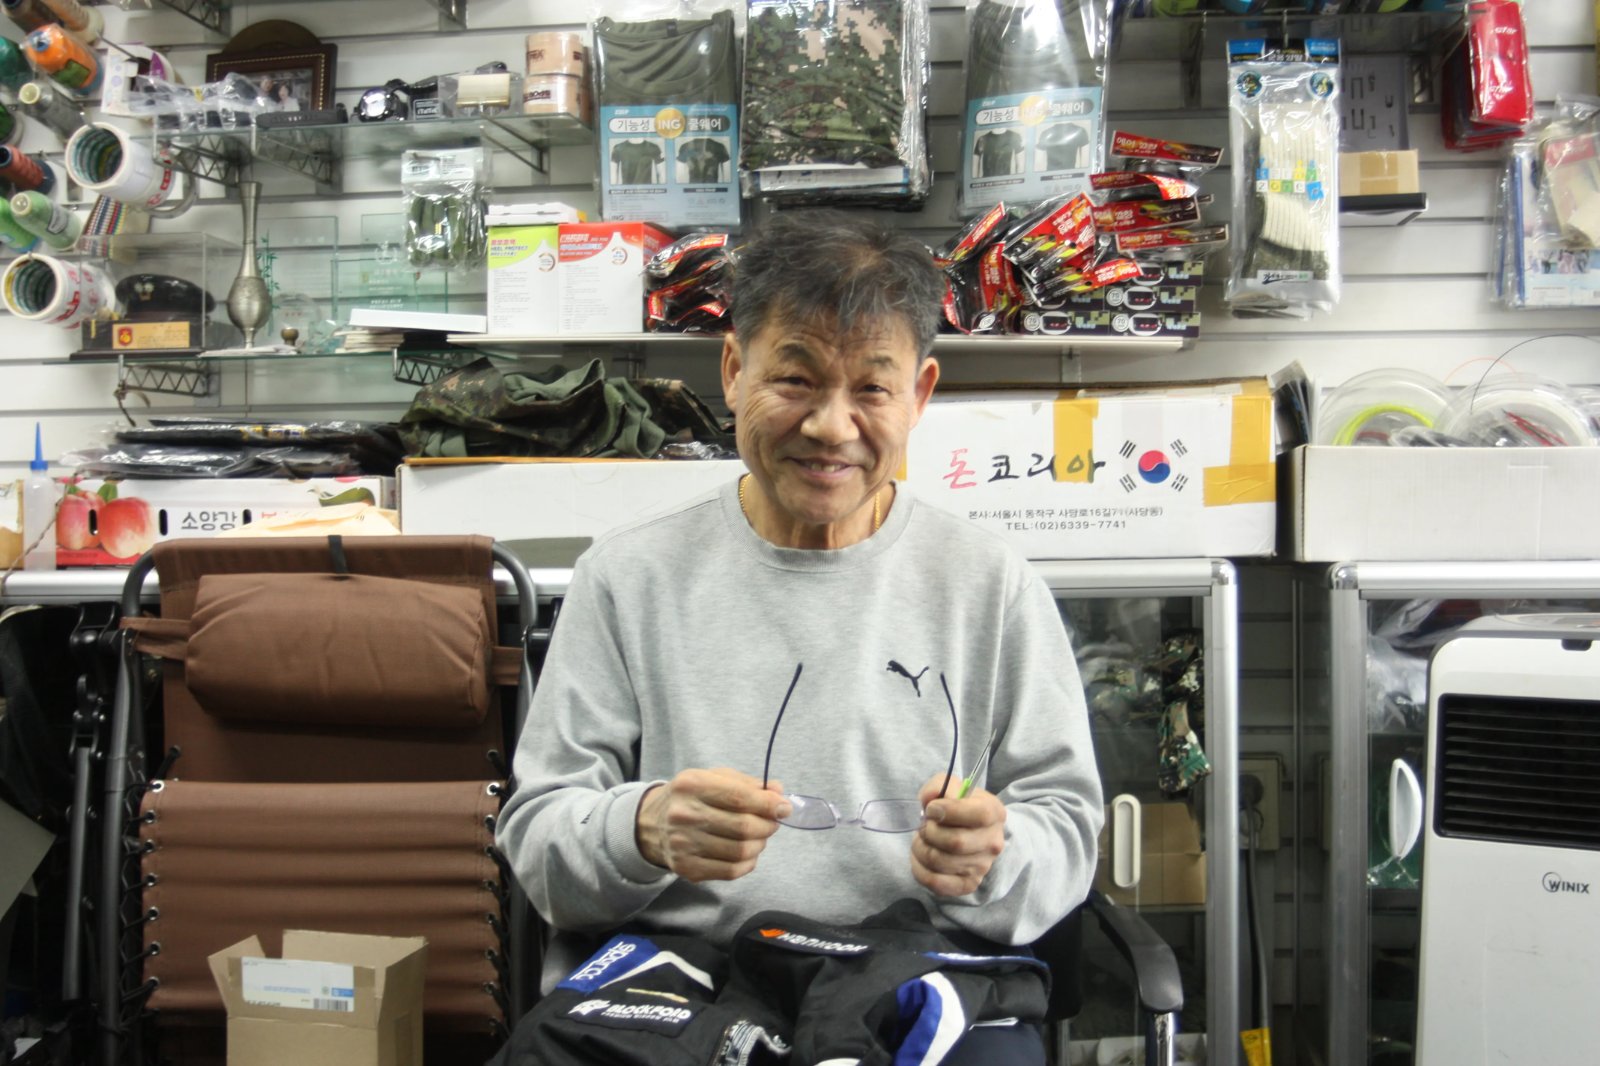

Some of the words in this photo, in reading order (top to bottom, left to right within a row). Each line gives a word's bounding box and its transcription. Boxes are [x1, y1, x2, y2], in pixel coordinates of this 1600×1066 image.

[983, 109, 1015, 122] 기능성
[617, 119, 650, 131] 기능성
[658, 119, 681, 130] ING
[943, 448, 977, 489] 돈
[987, 448, 1106, 484] 코리아
[968, 509, 1021, 520] 본사:서울시
[1025, 508, 1055, 519] 동작구
[180, 510, 238, 532] 소양강
[1005, 520, 1126, 531] TEL:(02)6339-7741
[1546, 876, 1590, 894] WINIX
